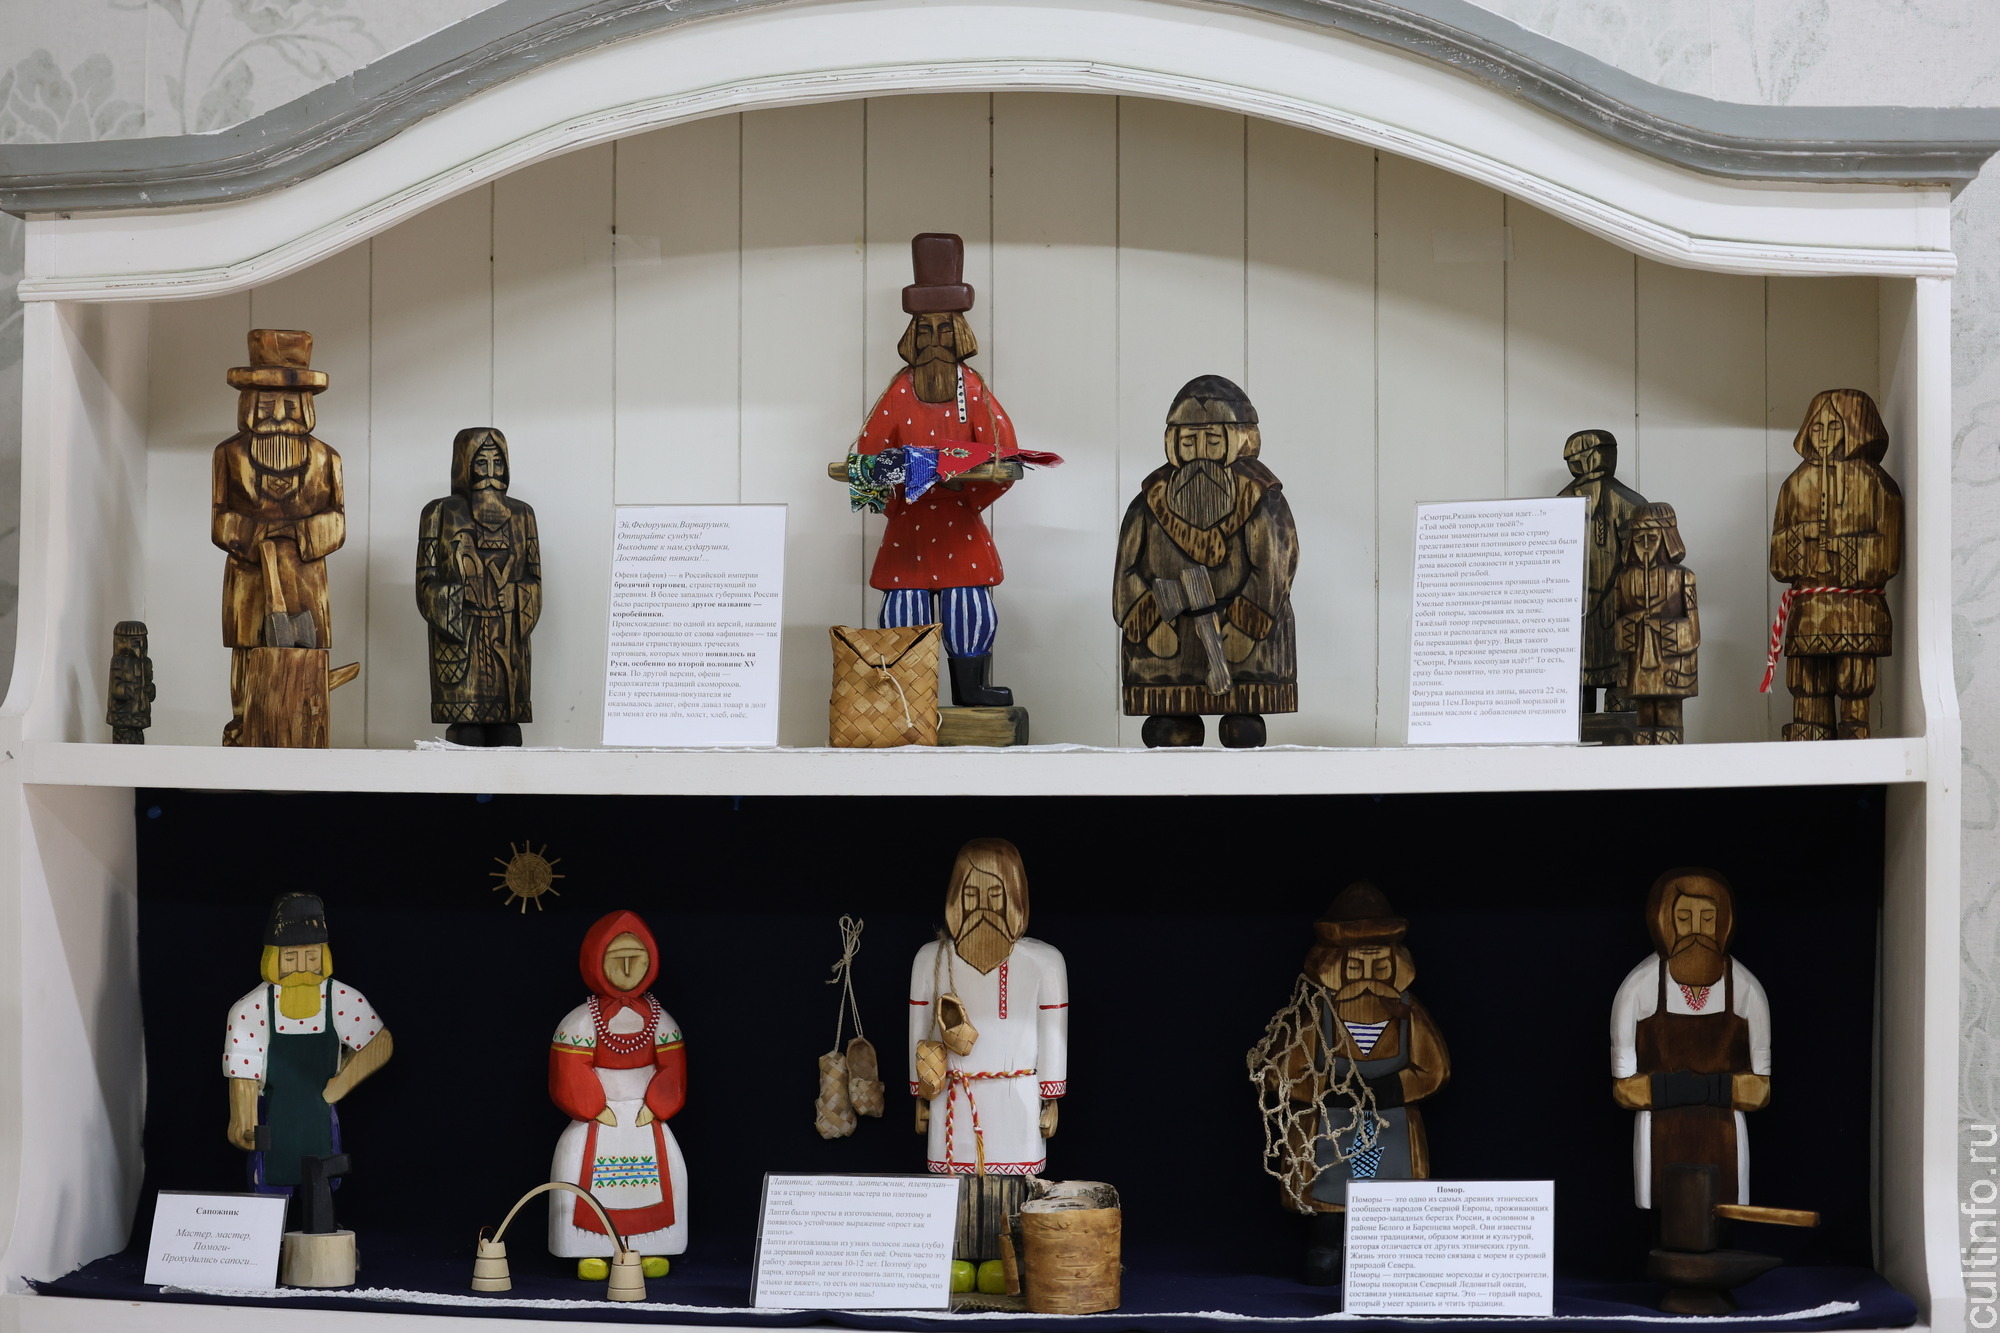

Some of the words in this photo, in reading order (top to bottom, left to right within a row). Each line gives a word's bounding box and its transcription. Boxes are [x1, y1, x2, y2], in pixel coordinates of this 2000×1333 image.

[617, 531, 666, 541] Отпирайте
[667, 531, 702, 541] сундуки!
[617, 542, 658, 552] Выходите
[615, 553, 667, 562] Доставайте
[614, 571, 638, 580] Офеня
[639, 571, 667, 580] (афеня)
[614, 580, 650, 590] бродячий
[689, 581, 746, 590] странствующий
[715, 590, 752, 599] губерниях
[678, 659, 704, 669] второй
[1352, 1195, 1383, 1204] Поморы
[196, 1206, 239, 1216] Сапожник
[1351, 1204, 1391, 1213] сообществ
[1424, 1204, 1460, 1213] Северной
[1425, 1214, 1454, 1223] берегах
[1351, 1223, 1377, 1232] районе
[1412, 1223, 1451, 1232] Баренцева
[1428, 1232, 1459, 1242] образом
[193, 1241, 230, 1251] Помоги-
[162, 1252, 218, 1264] Прохудились
[1516, 1251, 1546, 1260] суровой
[1350, 1261, 1386, 1270] природой
[1350, 1271, 1381, 1280] Поморы
[1349, 1280, 1381, 1289] Поморы
[1419, 1280, 1457, 1289] Северный
[1458, 1280, 1501, 1288] Ледовитый
[1489, 1290, 1516, 1299] гордый
[1348, 1299, 1381, 1308] который
